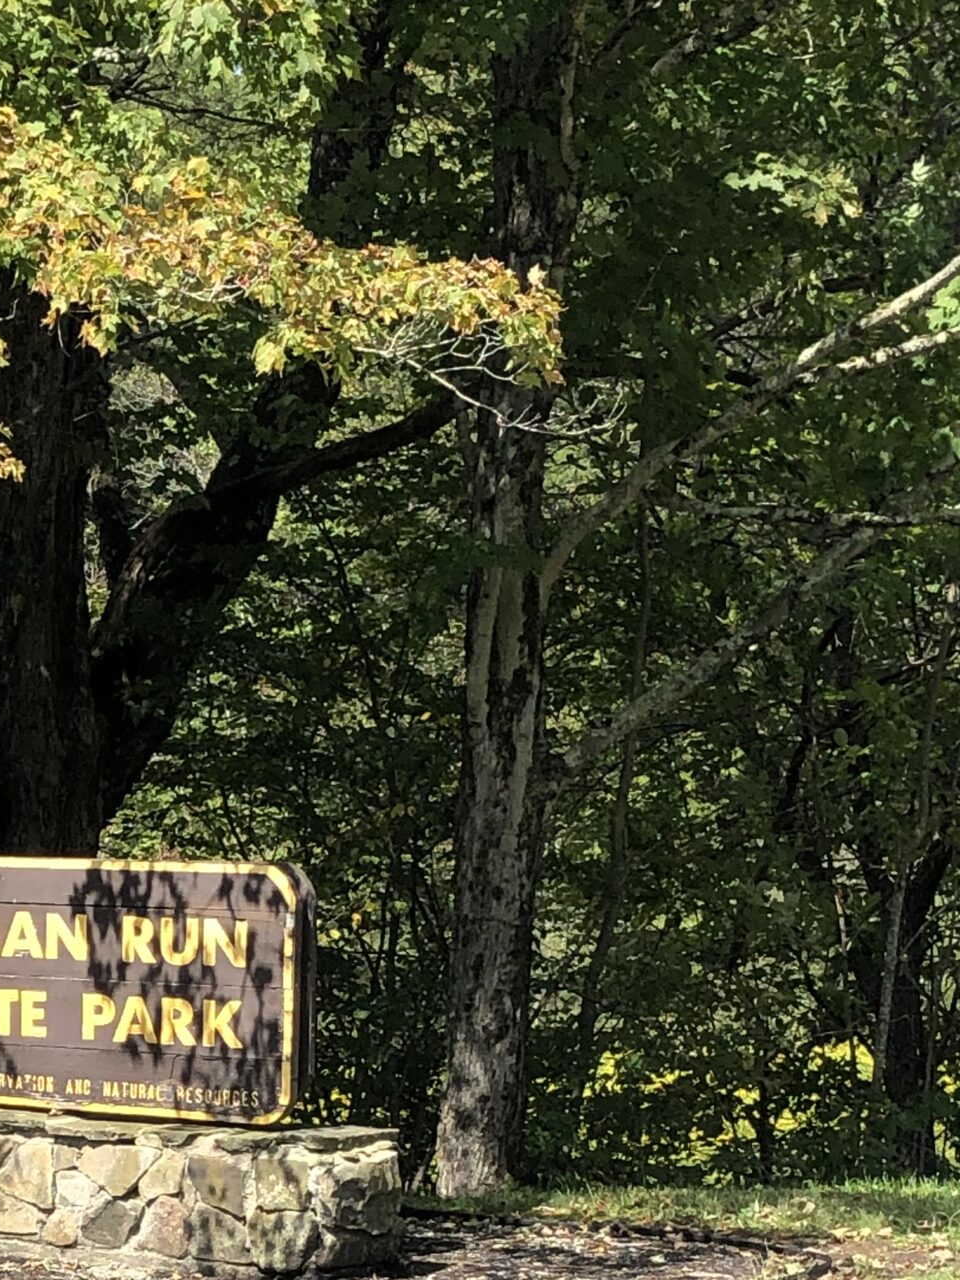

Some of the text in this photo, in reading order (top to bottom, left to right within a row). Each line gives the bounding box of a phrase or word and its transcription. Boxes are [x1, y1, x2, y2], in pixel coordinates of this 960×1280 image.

[122, 915, 248, 968] RUN
[82, 992, 244, 1049] PARK
[103, 1080, 163, 1102] NATURAL
[176, 1086, 260, 1108] RESOURCES
